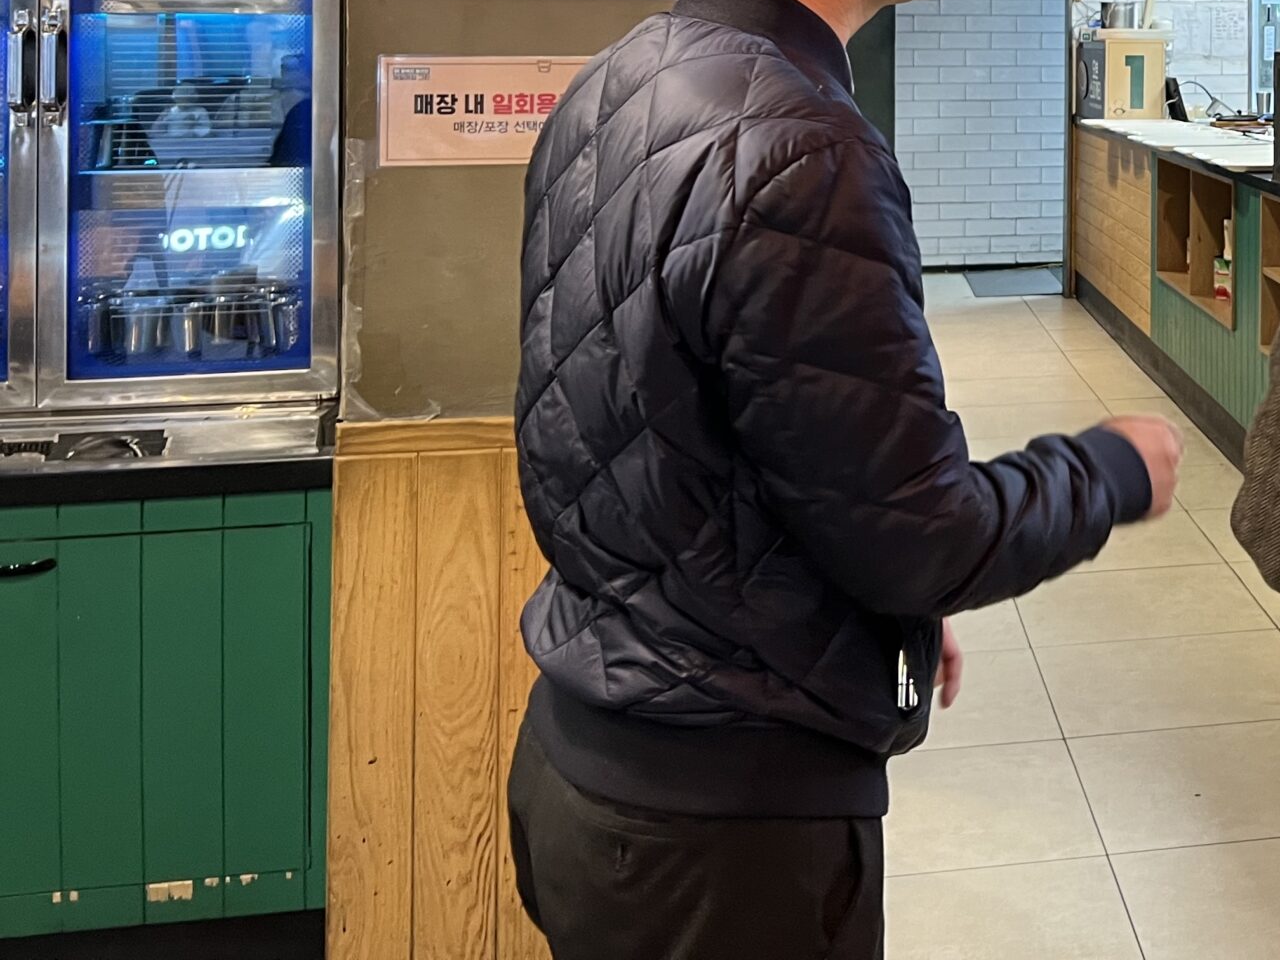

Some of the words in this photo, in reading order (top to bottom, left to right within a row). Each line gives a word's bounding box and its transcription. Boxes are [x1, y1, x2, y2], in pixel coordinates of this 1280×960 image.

[1125, 54, 1145, 110] 1
[413, 93, 458, 116] 매장
[464, 93, 485, 115] 내
[492, 93, 561, 115] 일회용
[453, 121, 509, 134] 매장/포장
